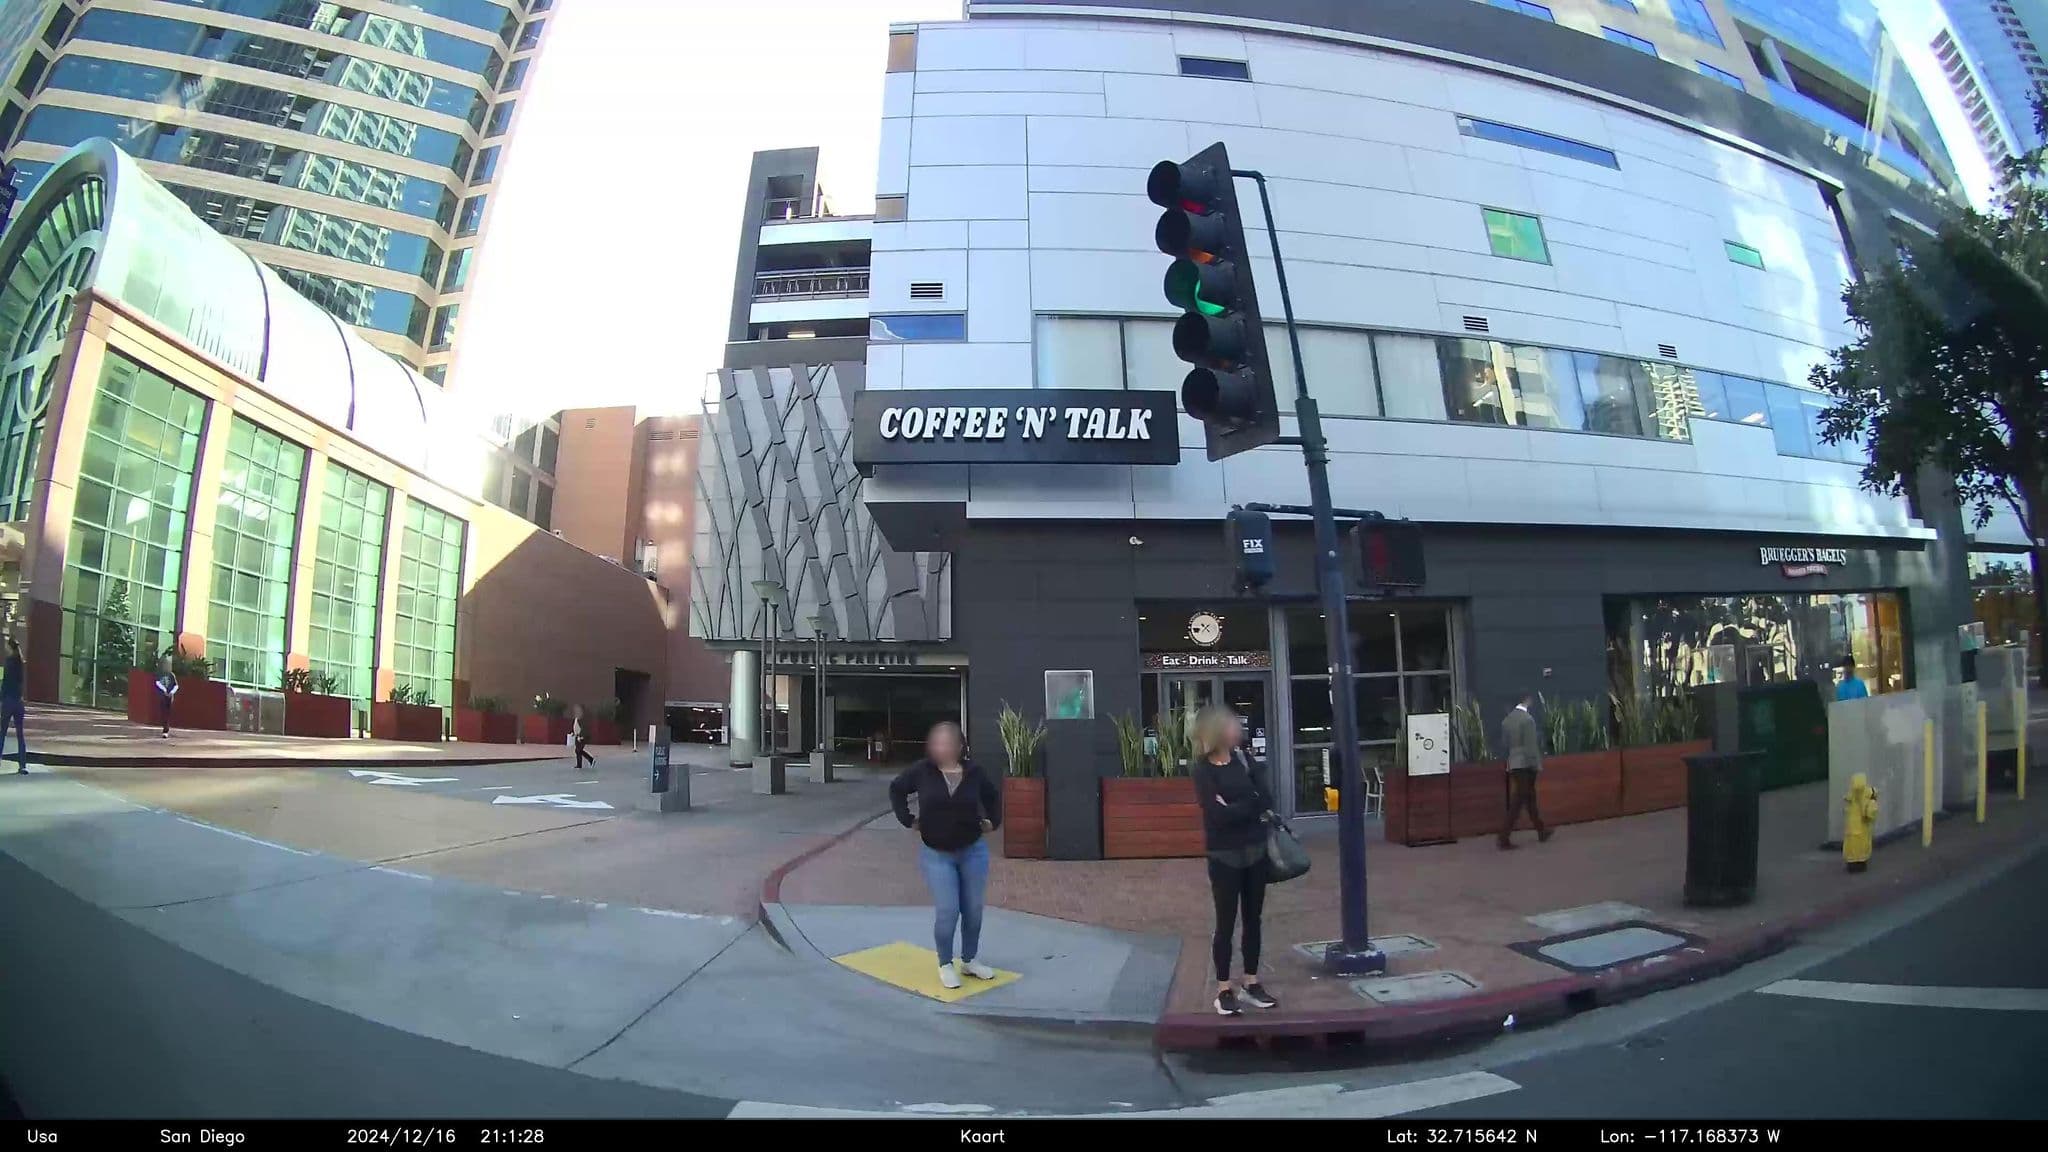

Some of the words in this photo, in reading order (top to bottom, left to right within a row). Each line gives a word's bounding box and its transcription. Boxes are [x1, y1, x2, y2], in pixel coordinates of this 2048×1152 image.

[879, 406, 1009, 439] COFFEE
[1064, 407, 1152, 440] TALK
[1242, 539, 1263, 548] FIX
[1760, 547, 1814, 565] BRUEGGER'S
[1162, 655, 1181, 665] Eat
[1189, 655, 1218, 665] Drink
[1226, 655, 1248, 665] Talk
